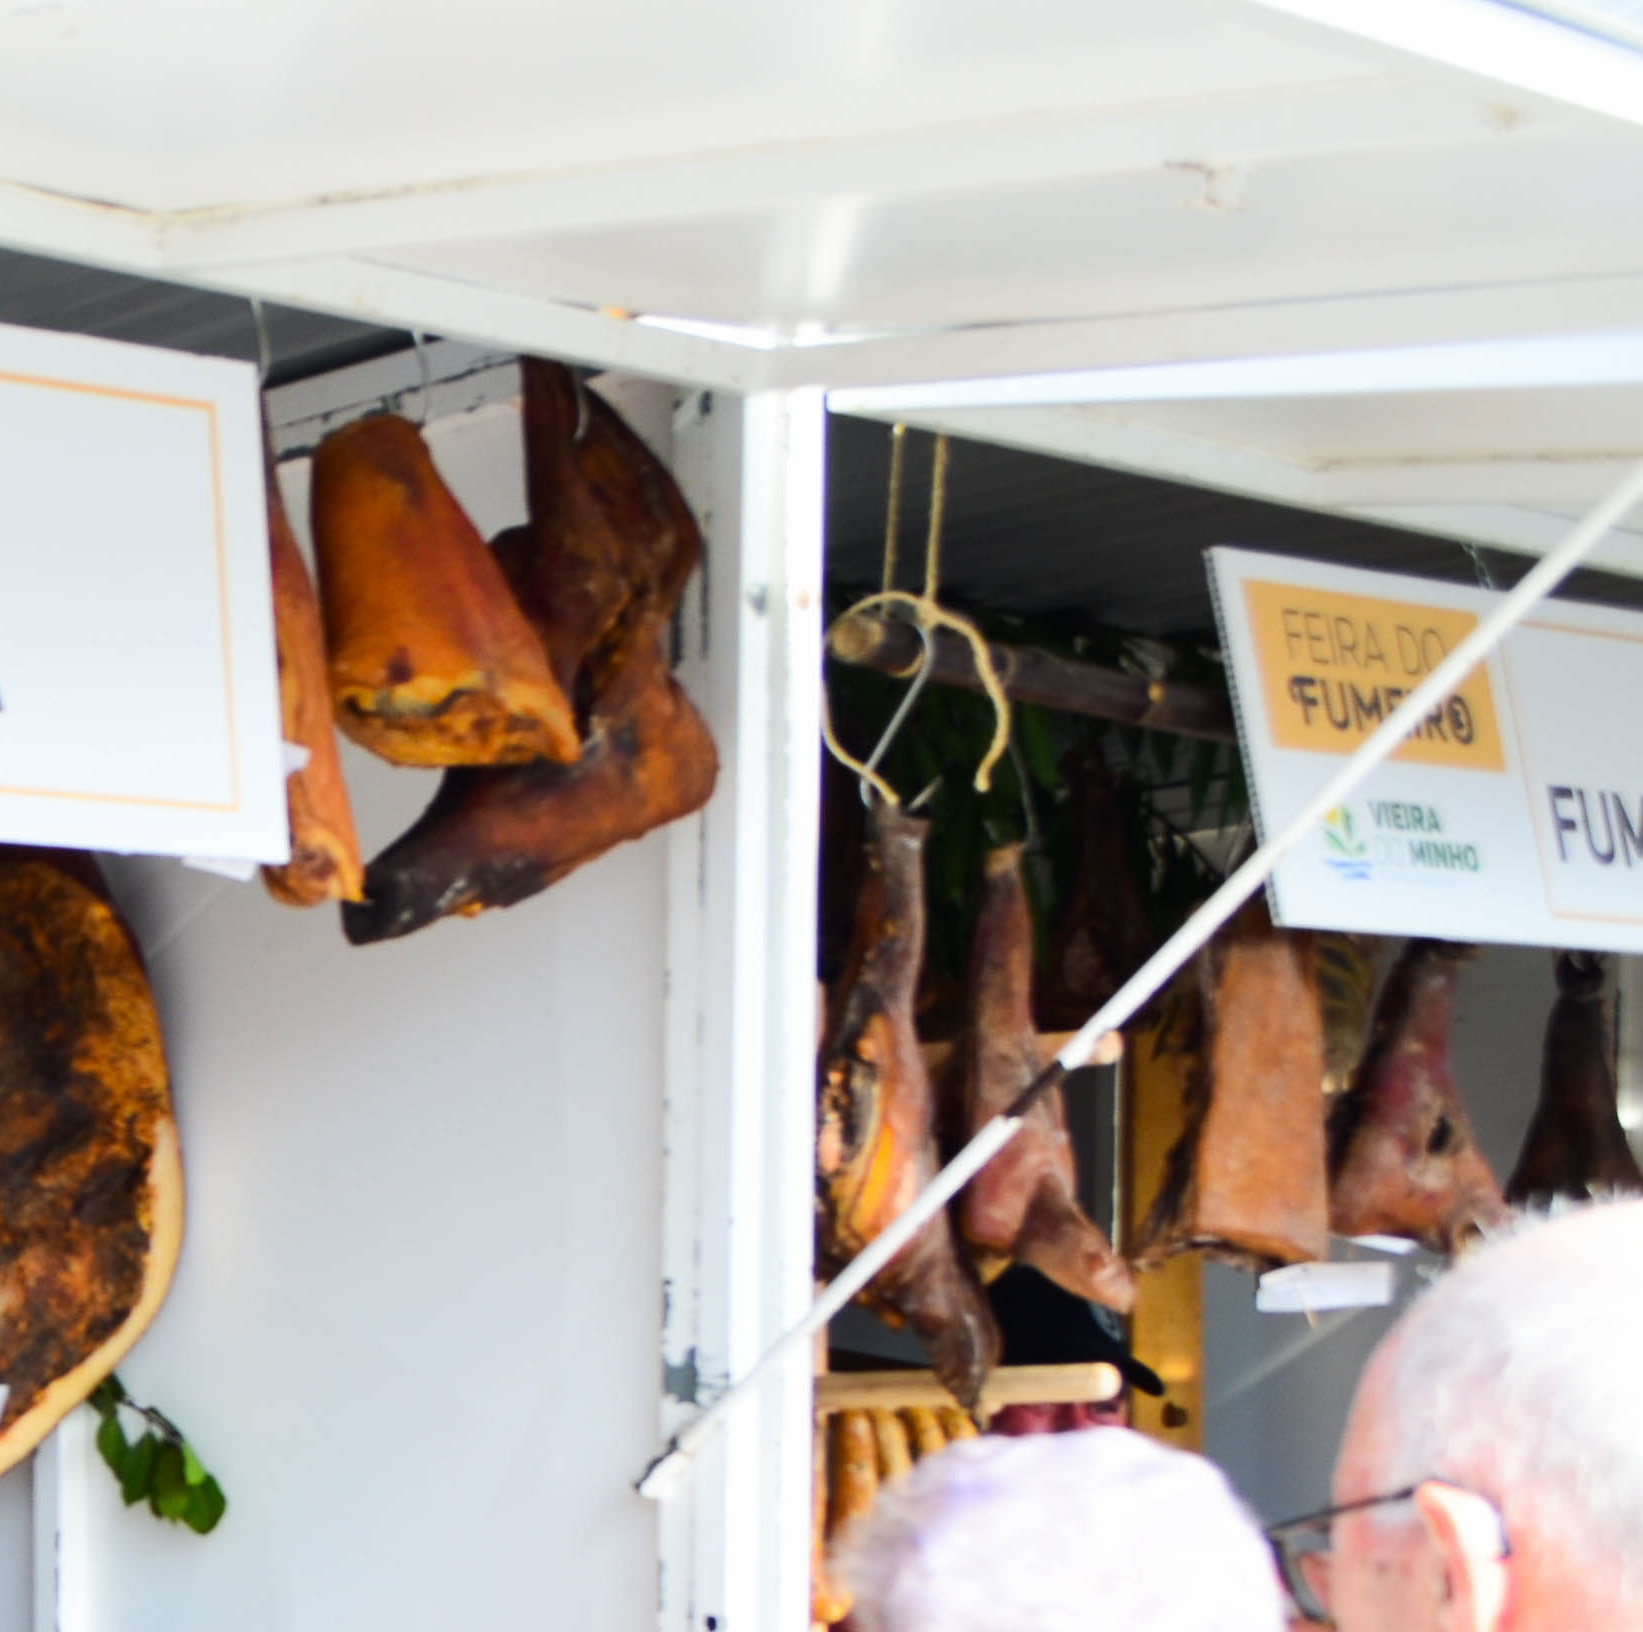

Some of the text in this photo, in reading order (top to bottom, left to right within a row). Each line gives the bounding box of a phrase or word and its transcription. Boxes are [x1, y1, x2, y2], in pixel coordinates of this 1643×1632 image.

[1281, 607, 1449, 676] FEIRA DO
[1368, 800, 1443, 834] VIEIRA
[1408, 838, 1480, 874] MINHO
